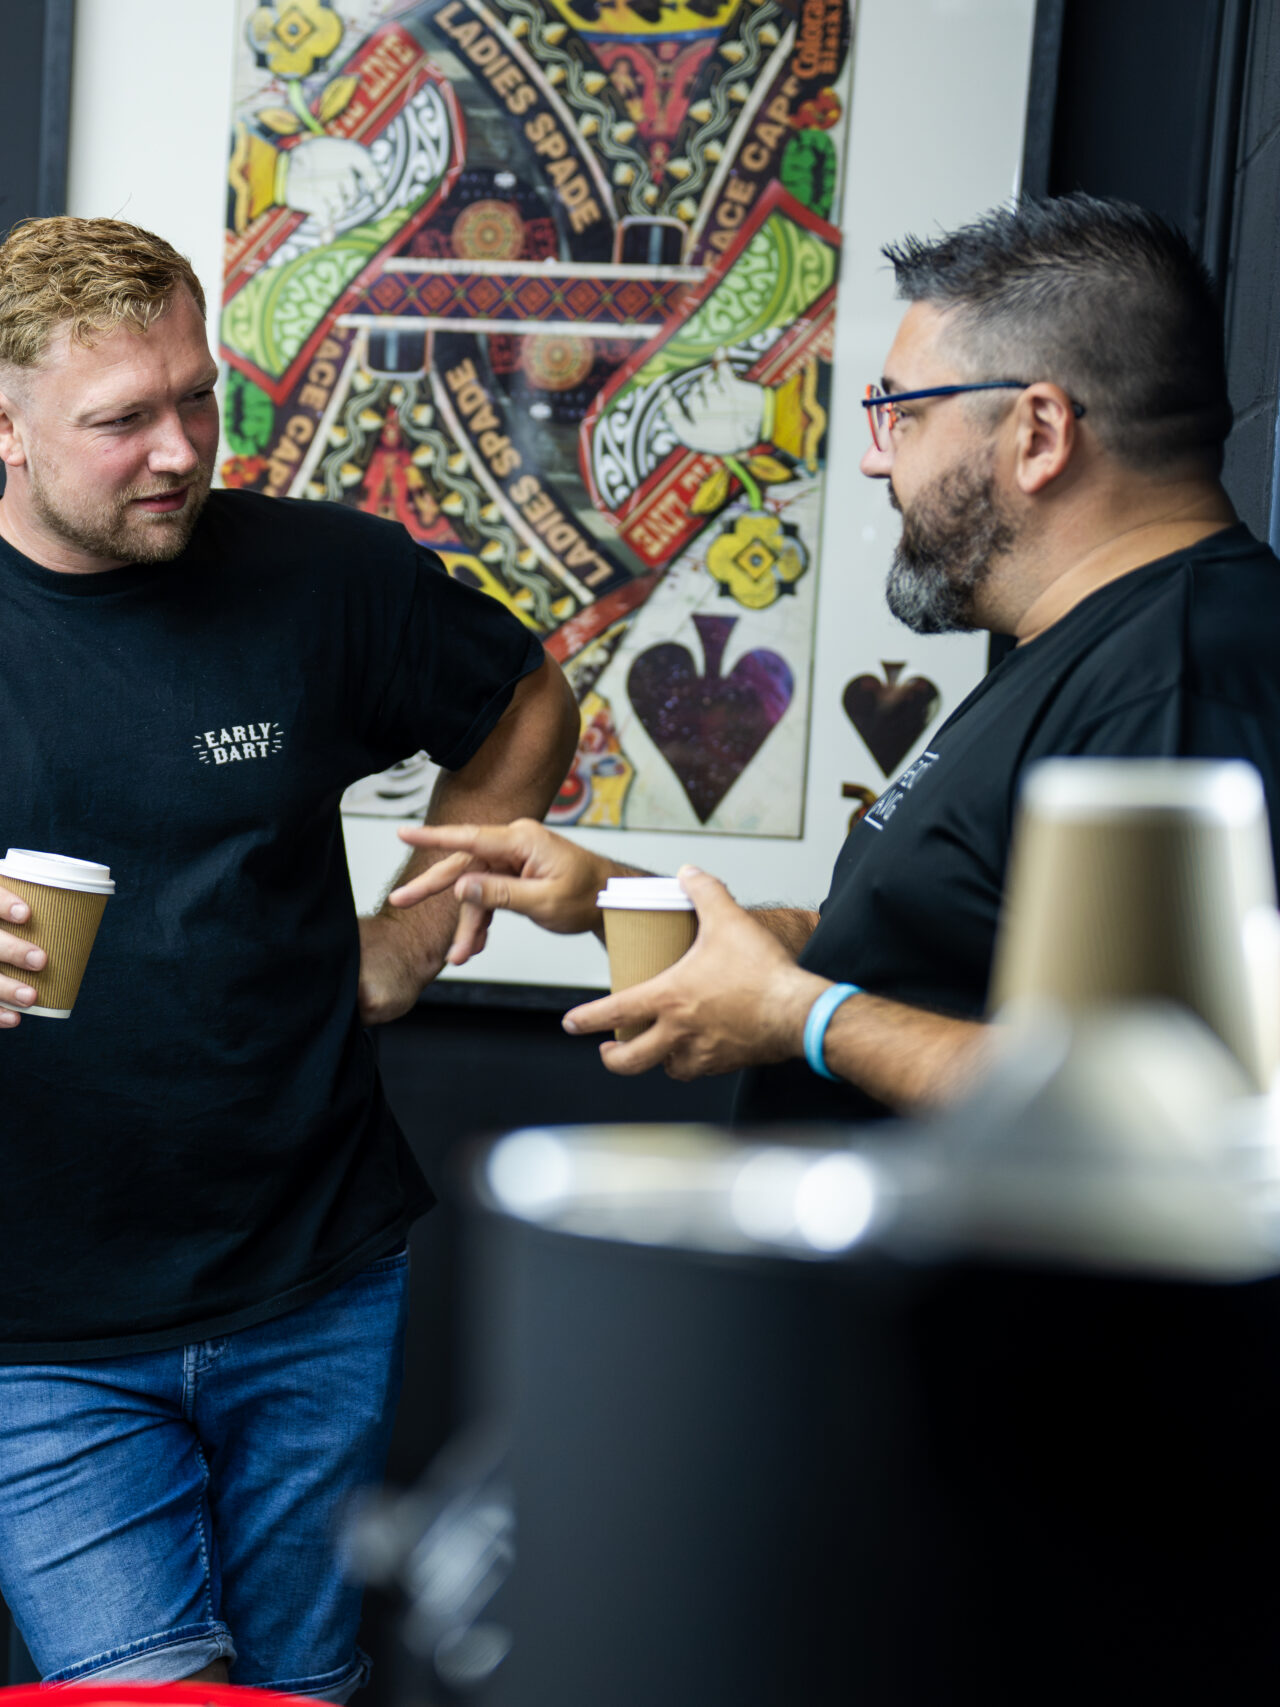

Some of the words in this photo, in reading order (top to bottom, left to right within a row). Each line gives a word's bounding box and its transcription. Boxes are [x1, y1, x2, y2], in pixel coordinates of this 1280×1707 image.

[434, 2, 538, 115] LADIES
[524, 112, 602, 235] SPADE
[445, 357, 523, 479] SPADE
[509, 473, 615, 587] LADIES
[204, 722, 271, 749] EARLY
[212, 741, 269, 765] DART
